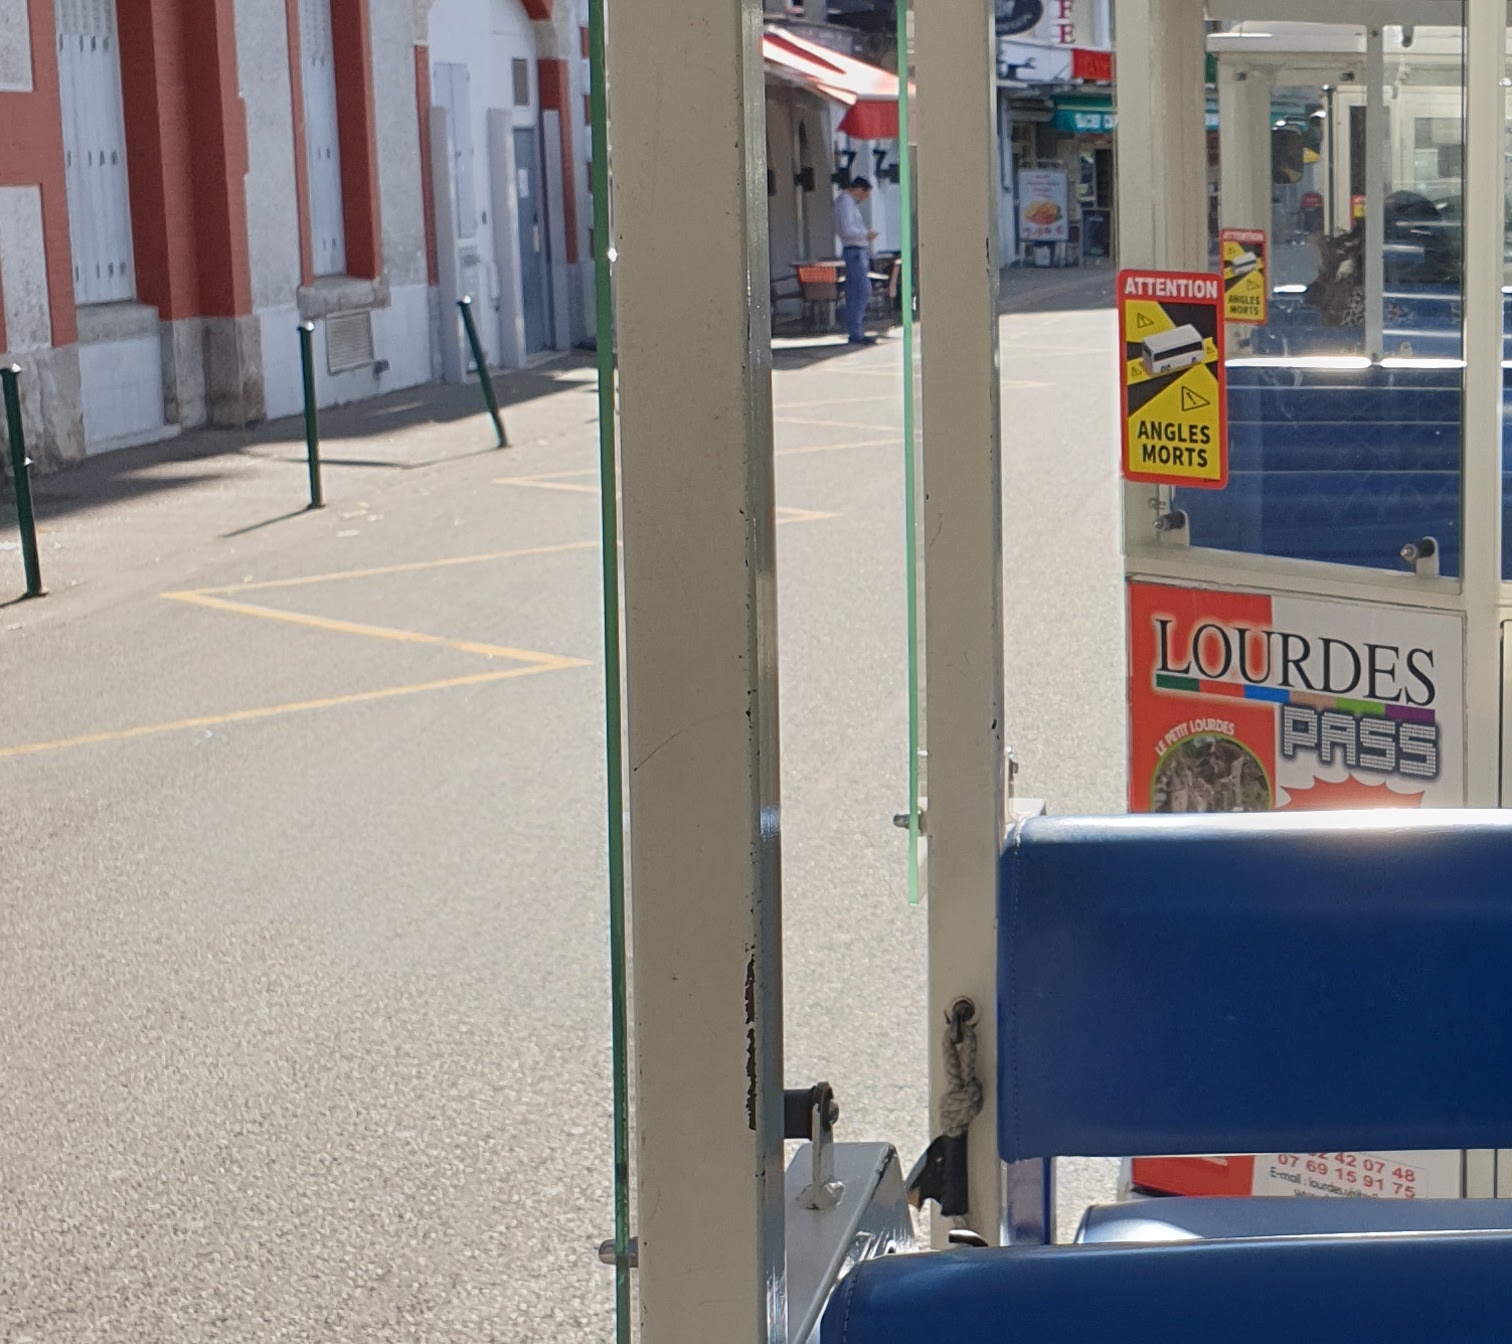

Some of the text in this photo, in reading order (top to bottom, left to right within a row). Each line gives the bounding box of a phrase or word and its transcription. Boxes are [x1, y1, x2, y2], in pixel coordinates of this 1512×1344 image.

[1124, 276, 1219, 299] ATTENTION
[1228, 294, 1261, 306] ANGLES
[1229, 305, 1260, 316] MORTS
[1137, 420, 1211, 445] ANGLES
[1141, 444, 1209, 468] MORTS
[1155, 618, 1436, 707] LOURDES
[1155, 717, 1237, 756] LE PETIT LOURDES
[1282, 704, 1437, 777] PASS
[1277, 1153, 1300, 1168] 07
[1306, 1160, 1328, 1176] 69
[1336, 1168, 1357, 1184] 15
[1362, 1175, 1384, 1191] 91
[1392, 1181, 1416, 1199] 75
[1334, 1152, 1357, 1168] 42
[1363, 1158, 1386, 1174] 07
[1392, 1167, 1416, 1183] 48
